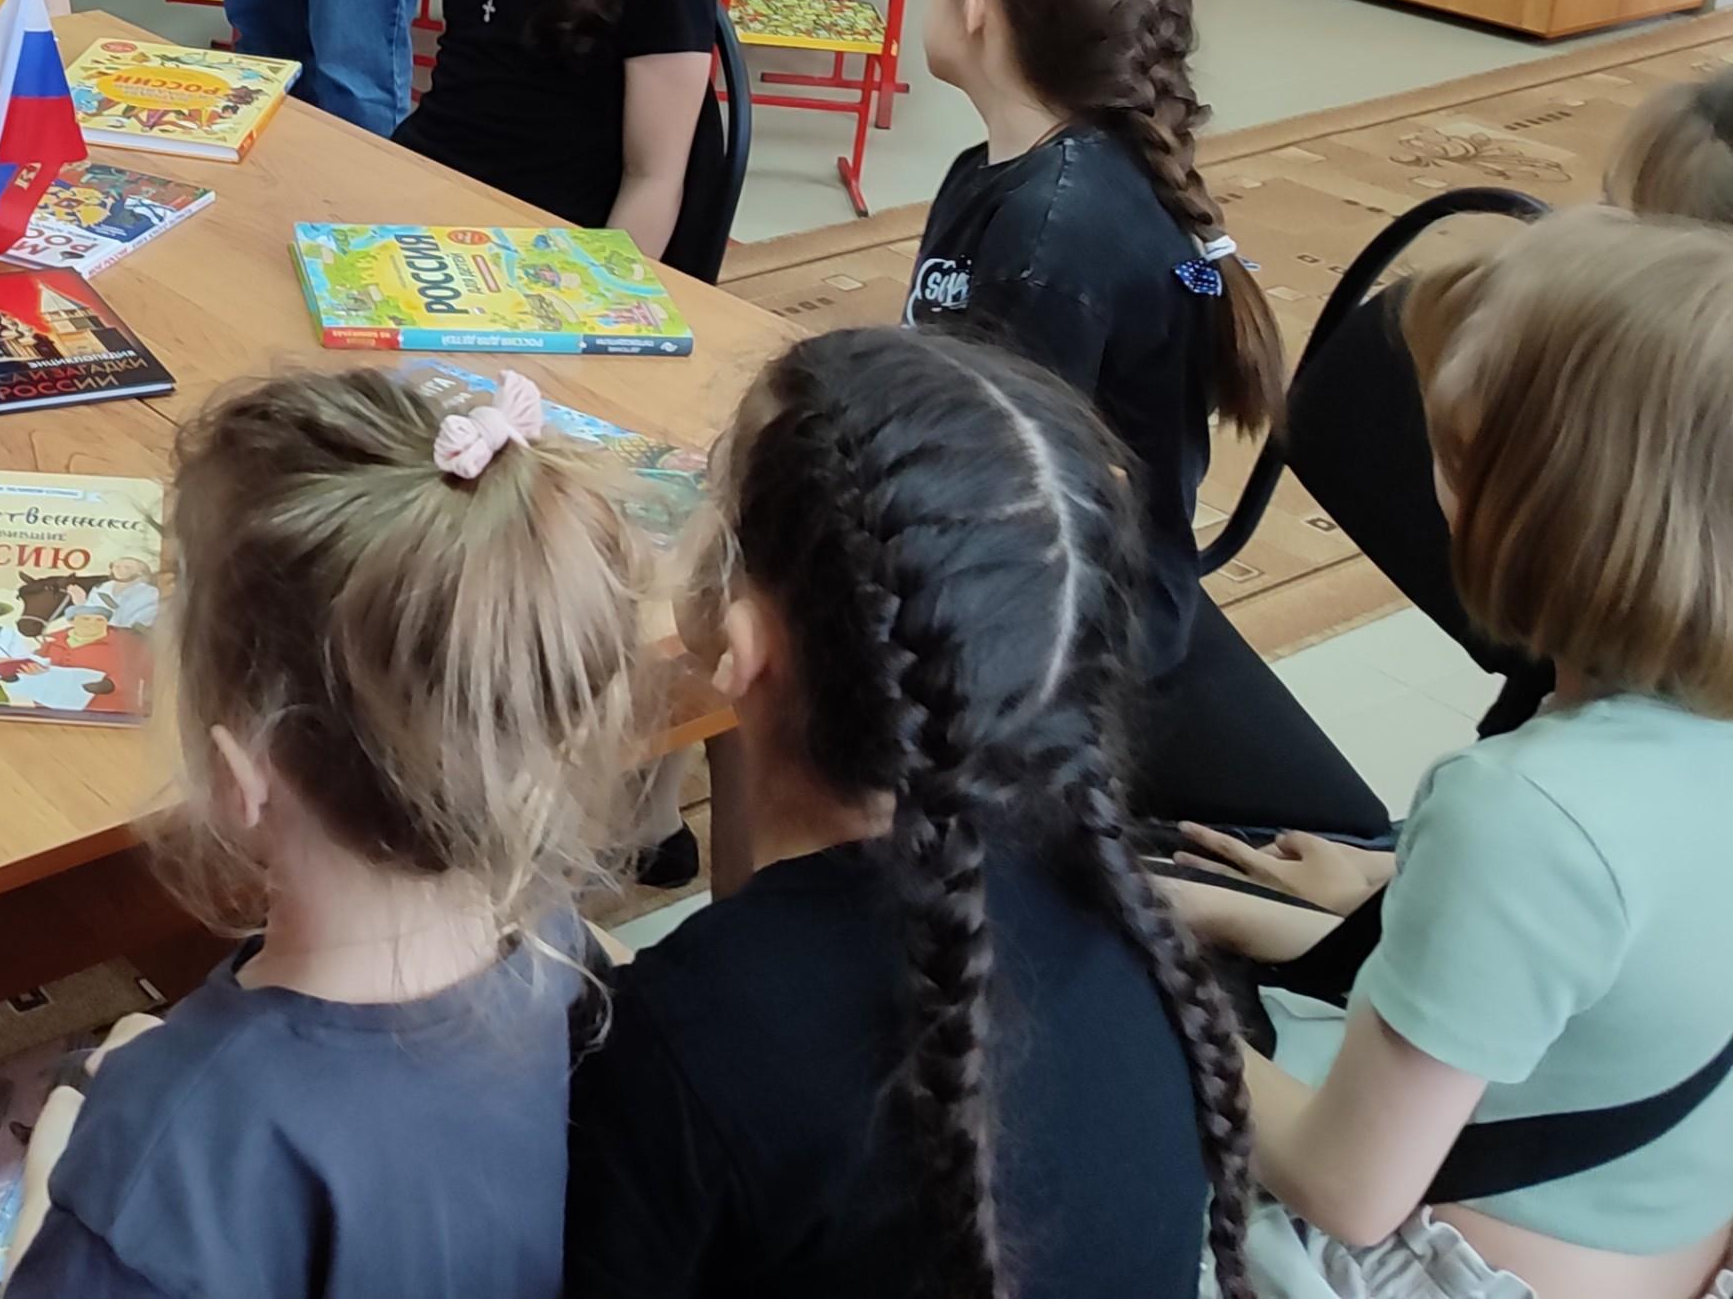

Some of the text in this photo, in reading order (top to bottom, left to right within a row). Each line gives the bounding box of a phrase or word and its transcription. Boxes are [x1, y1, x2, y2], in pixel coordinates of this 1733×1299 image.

[113, 75, 220, 96] РОССИИ
[394, 234, 469, 315] РОССИЯ
[27, 350, 137, 369] ЭНЦИКЛОПЕДИЯ
[30, 369, 49, 381] И
[53, 357, 149, 379] ЗАГАДКИ
